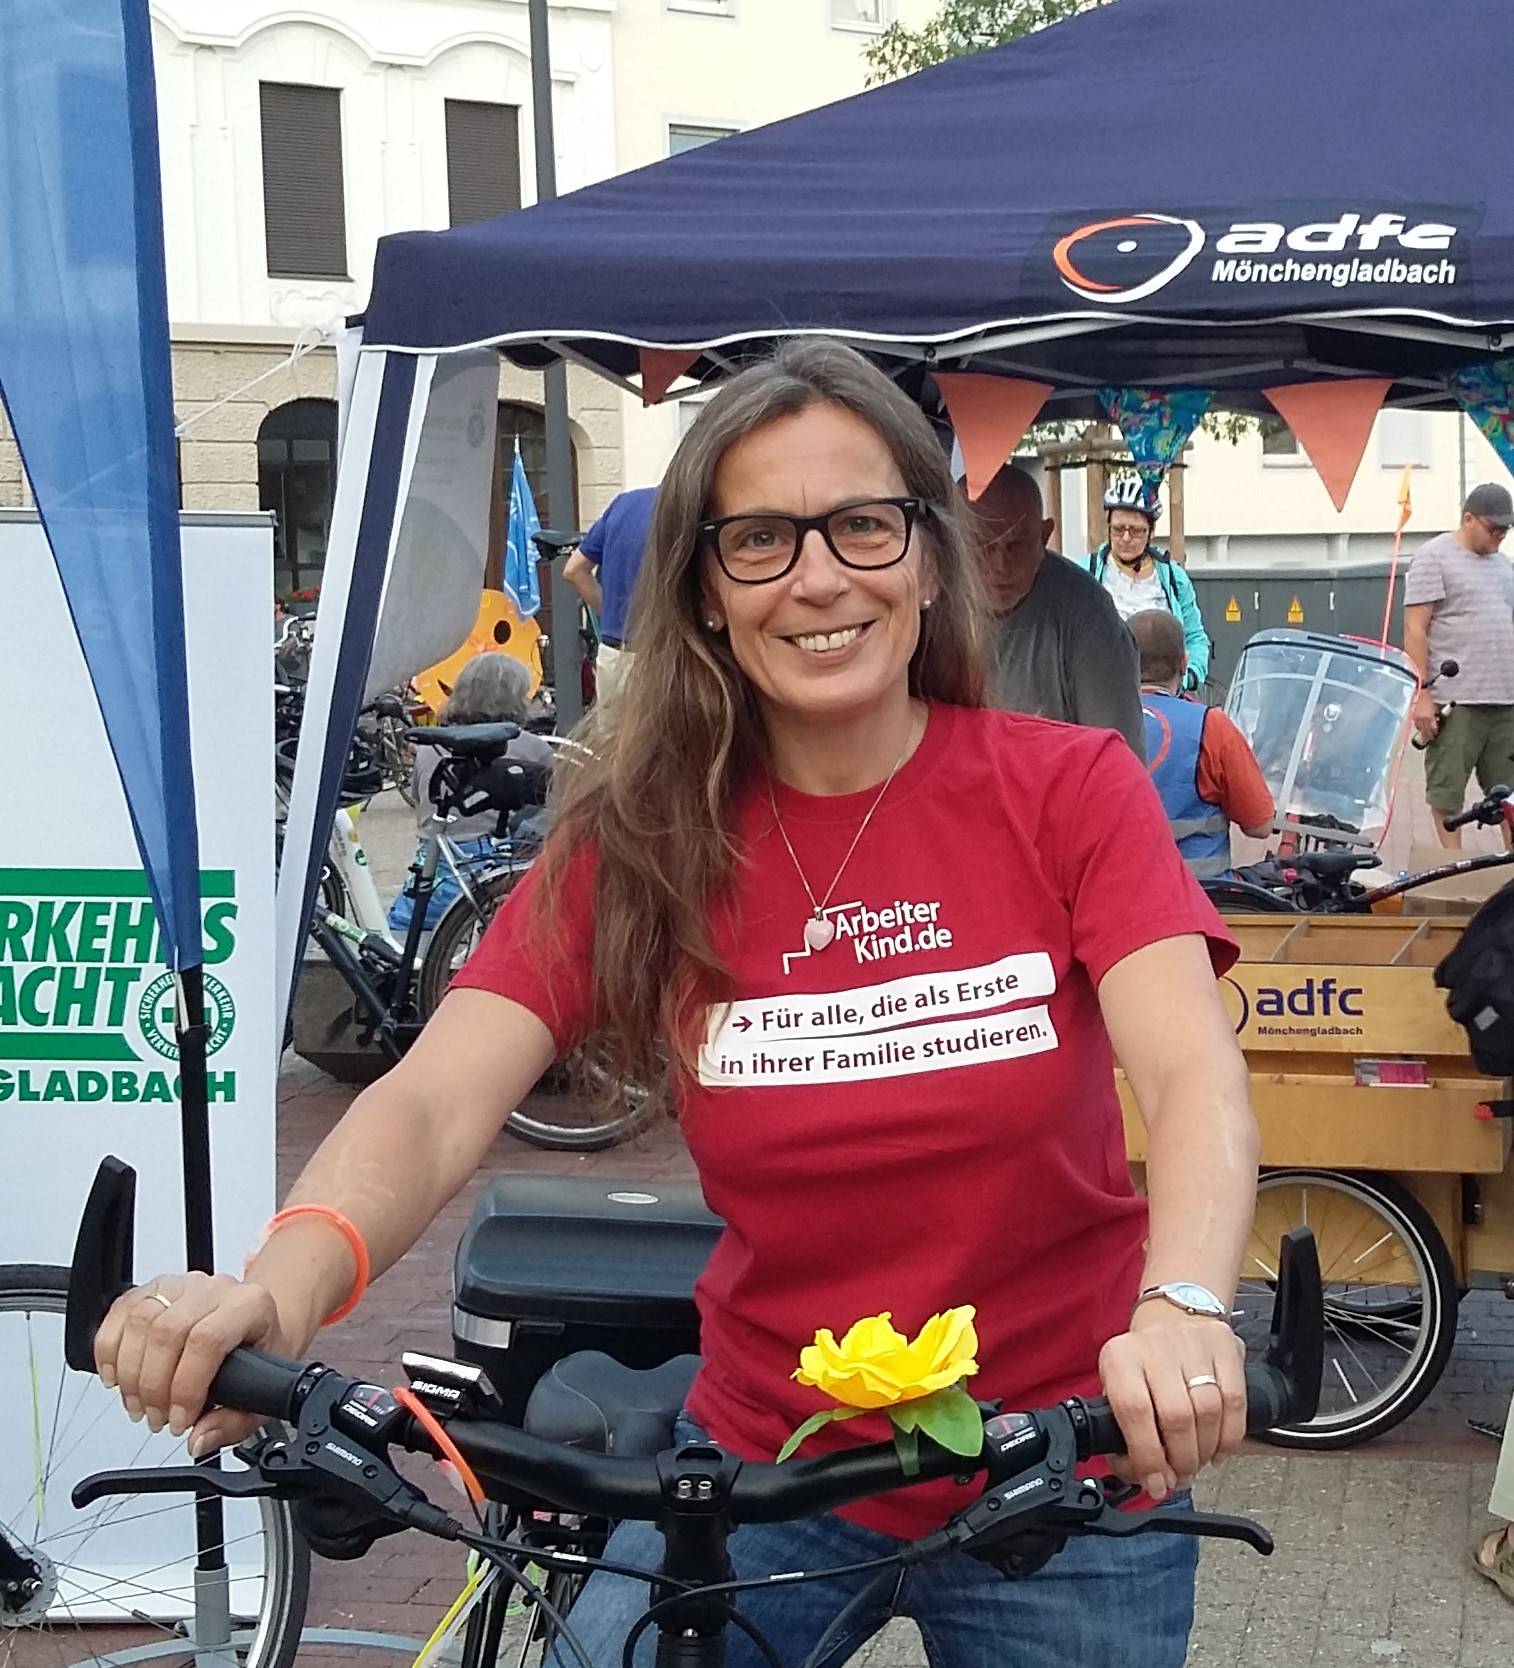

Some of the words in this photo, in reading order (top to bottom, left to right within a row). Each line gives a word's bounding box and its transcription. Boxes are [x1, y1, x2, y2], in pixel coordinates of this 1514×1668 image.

[1216, 213, 1458, 253] adfc
[1211, 258, 1456, 288] Mönchengladbach
[0, 901, 238, 964] RKEHS
[834, 900, 941, 941] Arbeiter
[853, 923, 953, 964] Kind.de
[762, 1009, 801, 1031] Für
[811, 1003, 864, 1027] alle,
[871, 993, 908, 1018] die
[914, 985, 950, 1009] als
[957, 974, 1019, 1002] Erste
[1256, 978, 1364, 1016] adfc
[720, 1054, 744, 1075] in
[752, 1051, 815, 1074] ihrer
[822, 1043, 916, 1071] Familie
[922, 1021, 1048, 1058] studieren.
[1258, 1026, 1363, 1037] Mönchengladbach
[0, 1070, 236, 1103] GLADBAH
[411, 1380, 461, 1399] SIGMA
